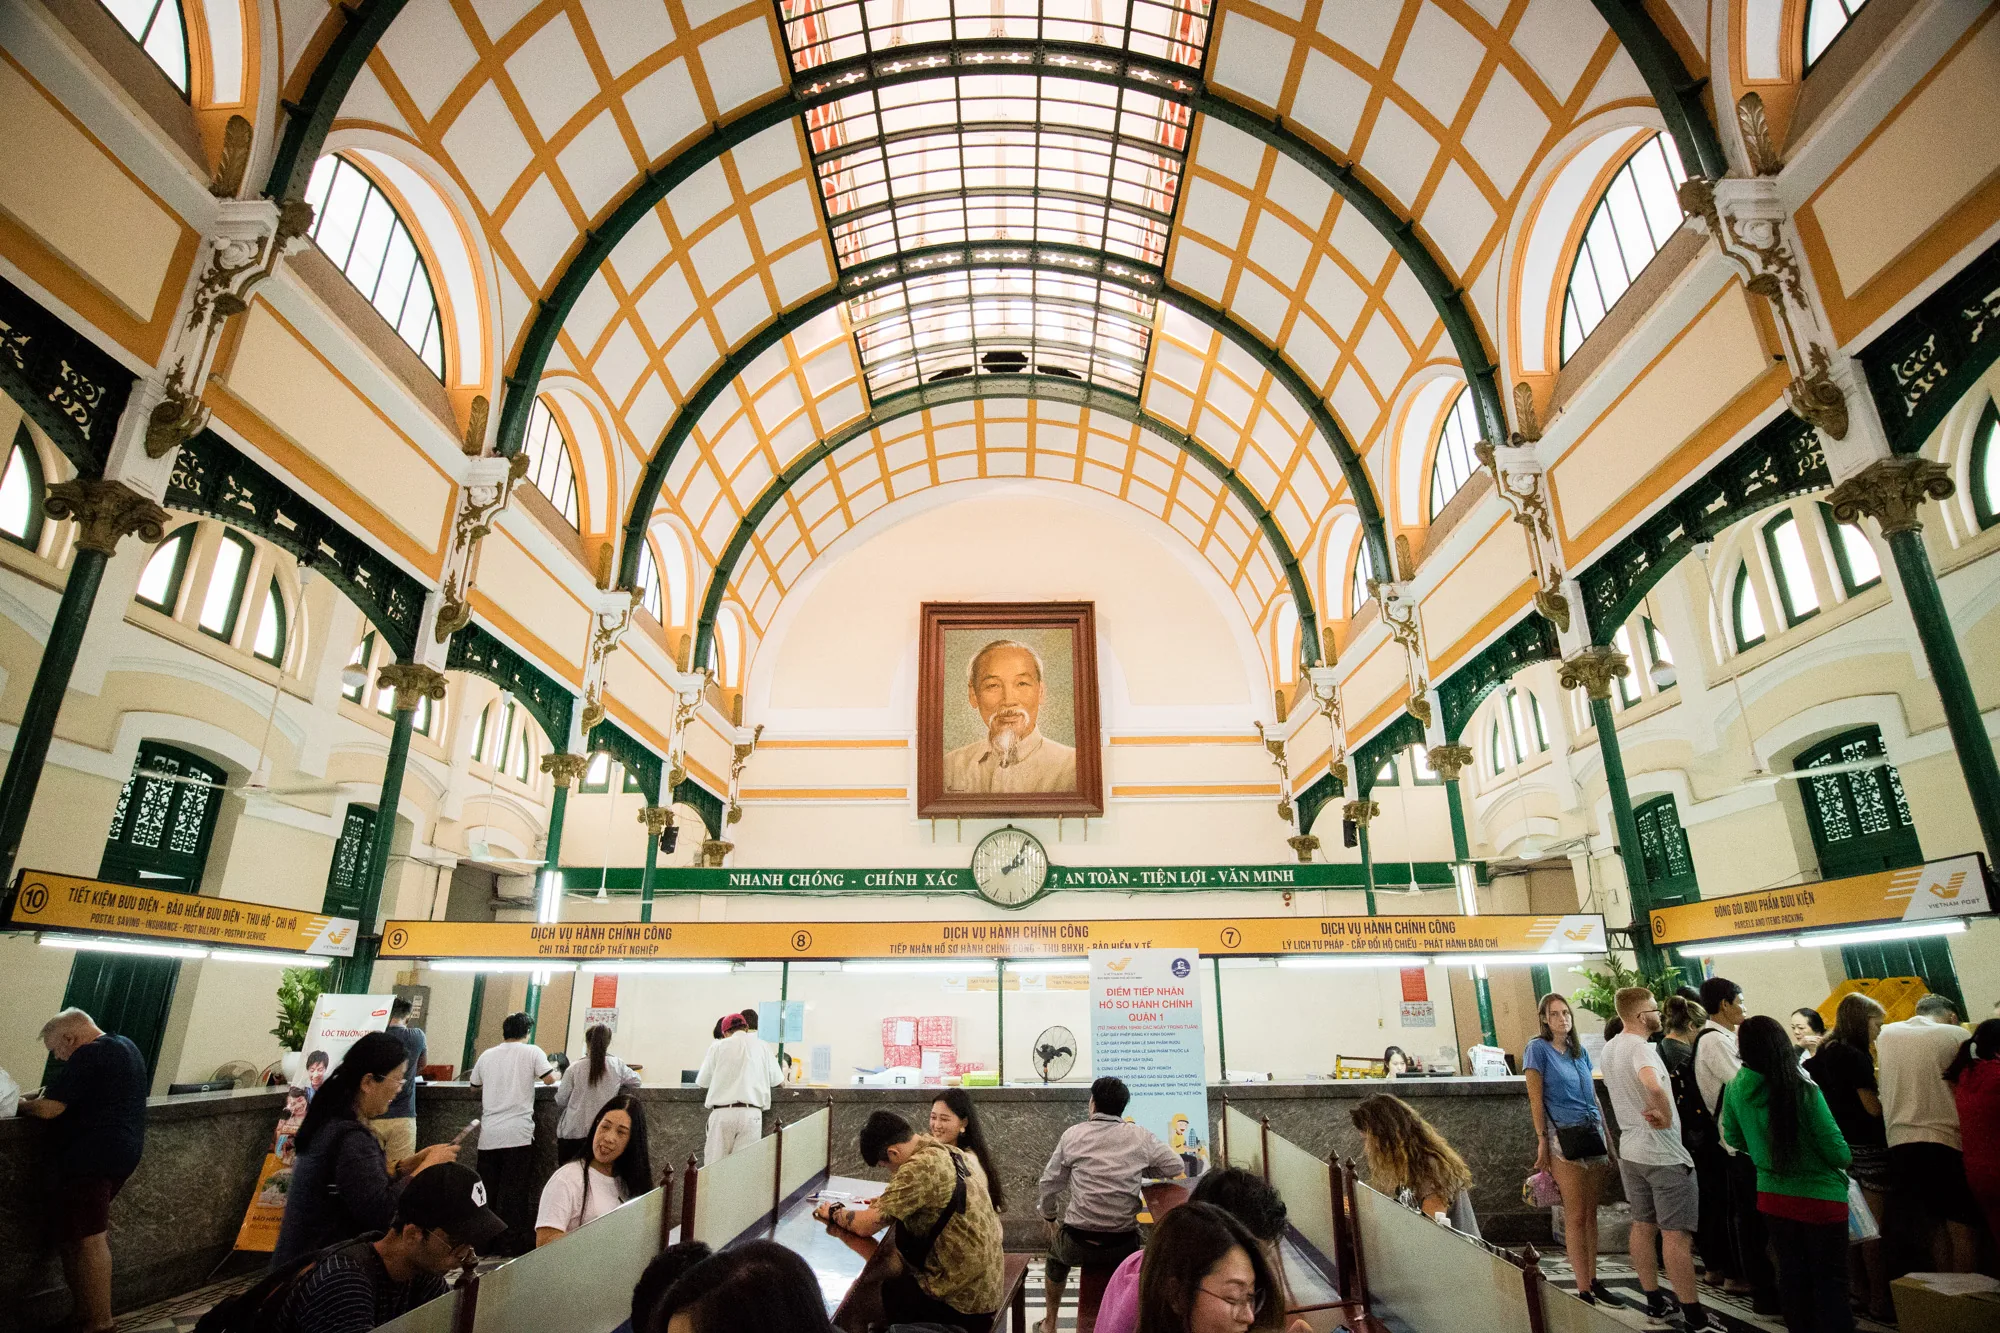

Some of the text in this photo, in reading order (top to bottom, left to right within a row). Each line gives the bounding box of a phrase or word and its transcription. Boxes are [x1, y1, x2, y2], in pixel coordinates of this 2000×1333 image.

[729, 870, 958, 886] NHANH CHÓNG CHÍNH XÁC
[1064, 868, 1294, 887] AN TOÀN TIỆN LỢI VĂN MINH
[26, 890, 45, 908] 10
[1714, 890, 1815, 918] ĐÓNG GÓI BƯU PHẨM BƯU KIỆN
[1928, 901, 1959, 909] VIETNAM
[68, 886, 297, 932] TIẾT KIỆM BƯU ĐIỆN BẢO HIỂM BƯU ĐIỆN THU HỘ CHI HỘ
[90, 913, 267, 941] POSTAL SAVING INSURANCE POST BILLPAY POSTPAY SERVICE
[1321, 919, 1456, 937] DỊCH VỤ HÀNH CHÍNH CÔNG
[1655, 920, 1662, 934] 6
[1734, 913, 1804, 929] PARCELS AND ITEMS PACKING
[392, 933, 402, 945] 9
[530, 925, 673, 942] DỊCH VỤ HÀNH CHÍNH CÔNG
[797, 934, 806, 947] 8
[943, 924, 1089, 942] DỊCH VỤ HÀNH CHÍNH CÔNG
[1225, 932, 1235, 944] 7
[538, 942, 659, 956] CHI TRẢ TRỢ CẤP THẤT NGHIỆP
[890, 940, 907, 954] TIẾP
[909, 943, 932, 955] NHẬN
[948, 943, 959, 954] SƠ
[960, 942, 983, 954] HÀNH
[984, 941, 1011, 954] CHÍNH
[1043, 943, 1059, 953] THU
[1062, 943, 1084, 953] BHXH
[1142, 939, 1153, 949] TẾ
[1282, 937, 1498, 951] LÝ LỊCH TƯ PHÁP CẤP ĐỔI HỘ CHIẾU PHÁT HÀNH BÁO CHÍ
[1116, 1000, 1130, 1009] SƠ
[1132, 998, 1159, 1009] HÀNH
[1162, 998, 1193, 1008] CHÍNH
[1128, 1012, 1164, 1023] QUẬN 1
